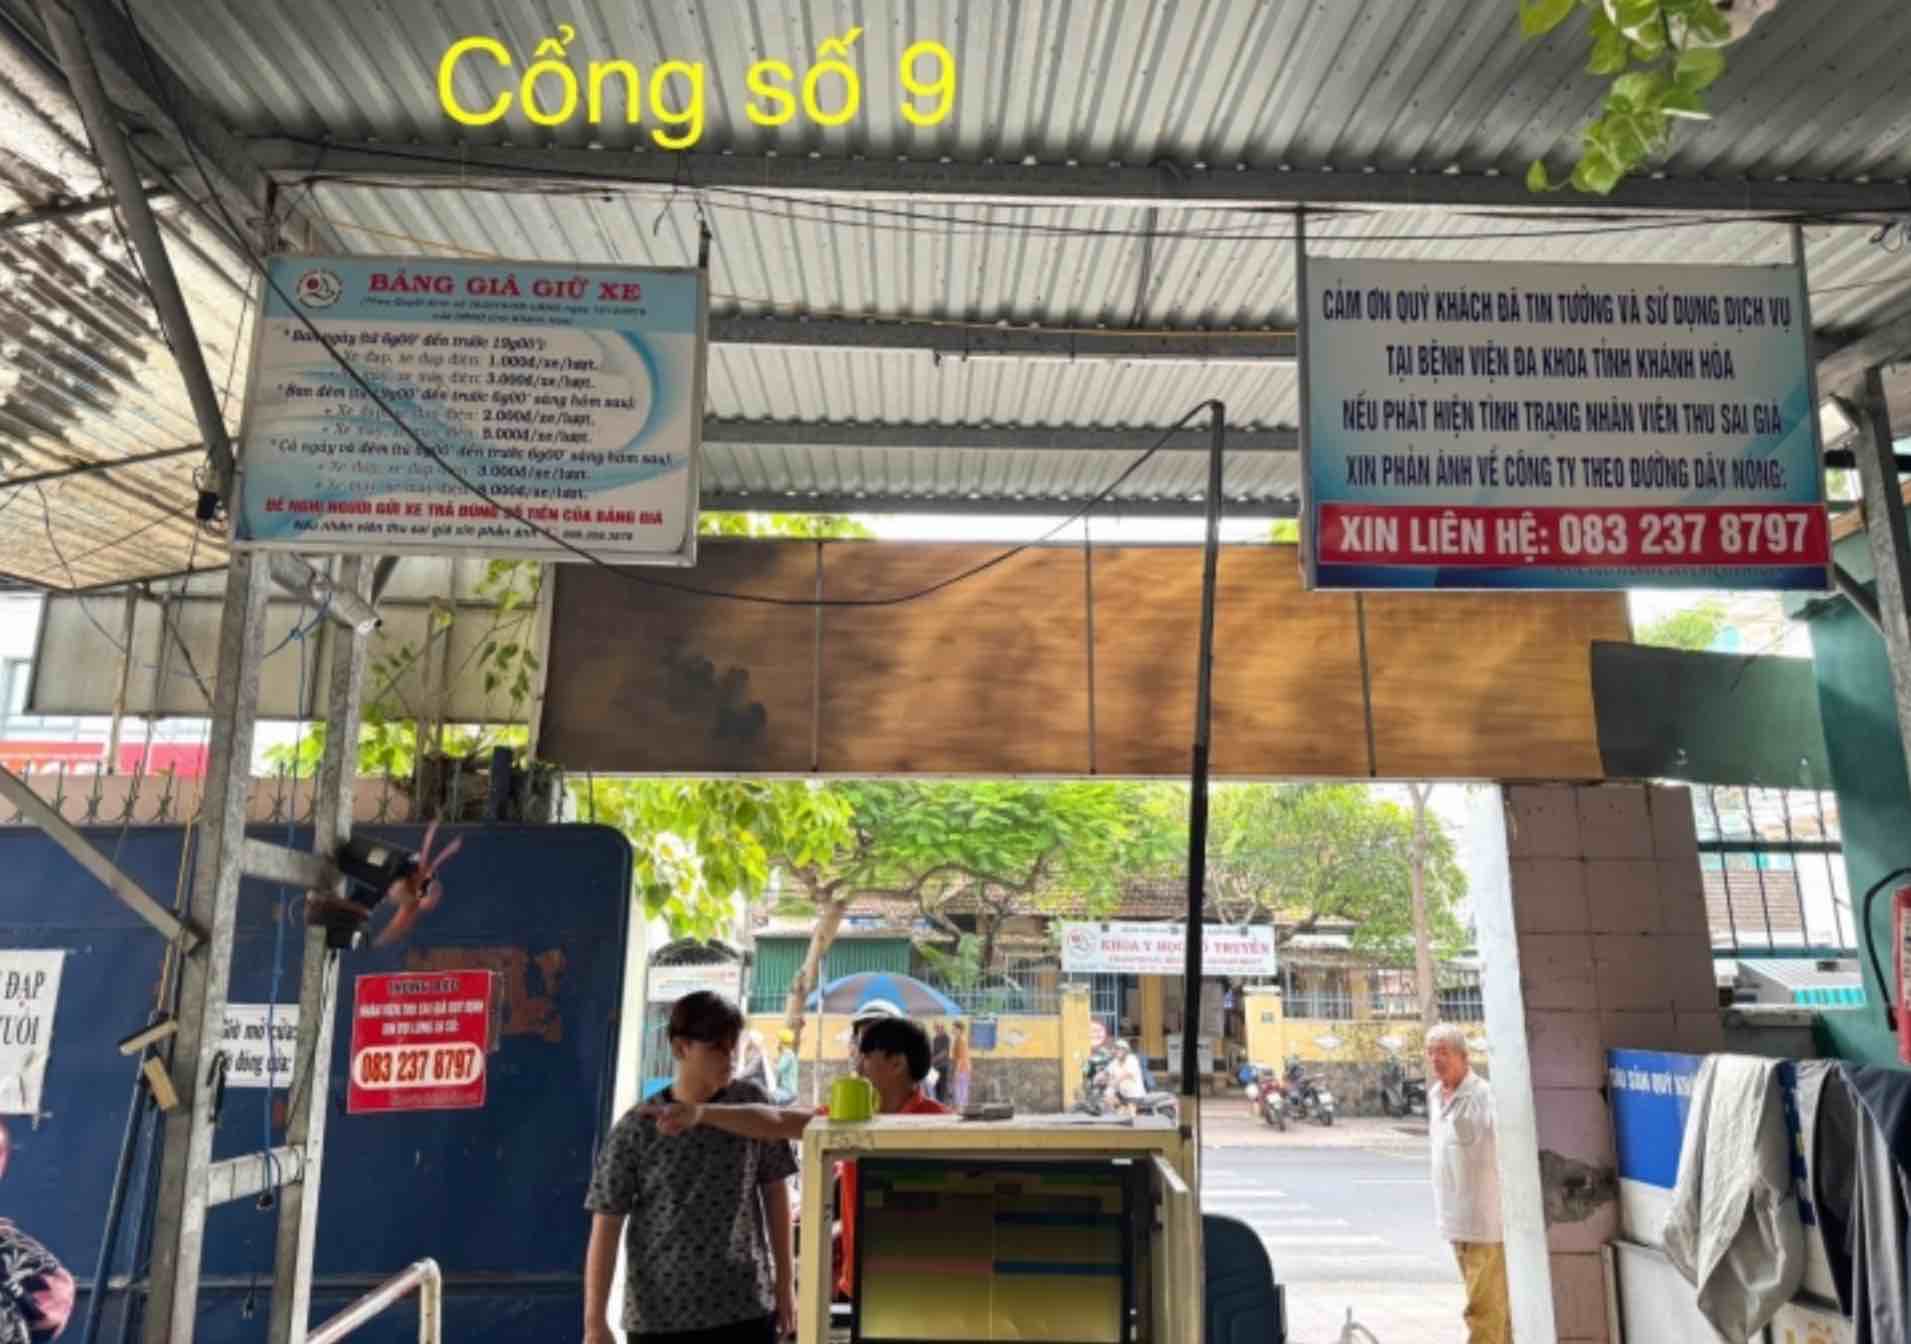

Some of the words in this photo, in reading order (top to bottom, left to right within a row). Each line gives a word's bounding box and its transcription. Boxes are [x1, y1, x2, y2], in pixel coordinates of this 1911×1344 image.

[368, 266, 455, 295] BẢNG
[466, 273, 520, 297] GIÁ
[598, 282, 642, 303] XE
[1322, 277, 1362, 321] CẢM
[1396, 284, 1430, 323] QUÝ
[1435, 284, 1493, 322] KHÁCH
[1497, 286, 1520, 322] ĐÃ
[1525, 292, 1553, 323] TIN
[1557, 284, 1613, 324] TƯỞNG
[1617, 288, 1641, 324] VÀ
[1646, 284, 1669, 325] SỬ
[1673, 296, 1720, 333] DỤNG
[1724, 296, 1765, 334] DỊCH
[1768, 297, 1792, 334] VỤ
[1386, 344, 1413, 384] TẠI
[1418, 338, 1465, 384] BỆNH
[1469, 338, 1510, 384] VIỆN
[1514, 345, 1537, 377] ĐA
[1542, 346, 1588, 378] KHOA
[1591, 336, 1632, 379] TỈNH
[1636, 341, 1696, 379] KHÁNH
[1342, 388, 1377, 431] NẾU
[1383, 393, 1428, 431] PHÁT
[1433, 393, 1474, 439] HIỆN
[1479, 392, 1520, 431] TÌNH
[1524, 400, 1581, 440] TRẠNG
[1585, 395, 1634, 432] NHÂN
[1638, 395, 1679, 433] VIÊN
[1682, 403, 1716, 433] THU
[1720, 402, 1748, 434] SAI
[1753, 397, 1782, 435] GIÁ
[1346, 455, 1377, 487] XIN
[1382, 443, 1430, 487] PHẢN
[1504, 448, 1553, 488] CÔNG
[1556, 456, 1576, 487] TY
[1582, 456, 1625, 489] THEO
[1629, 449, 1689, 489] ĐƯỜNG
[1695, 451, 1726, 489] DÂY
[1339, 514, 1399, 553] XIN
[1409, 511, 1485, 555] LIÊN
[1496, 510, 1551, 563] HỆ:
[1558, 514, 1629, 555] 083
[1639, 514, 1708, 555] 237
[1719, 513, 1809, 555] 8797
[362, 1051, 392, 1082] 083
[398, 1050, 429, 1080] 237
[433, 1048, 476, 1079] 8797
